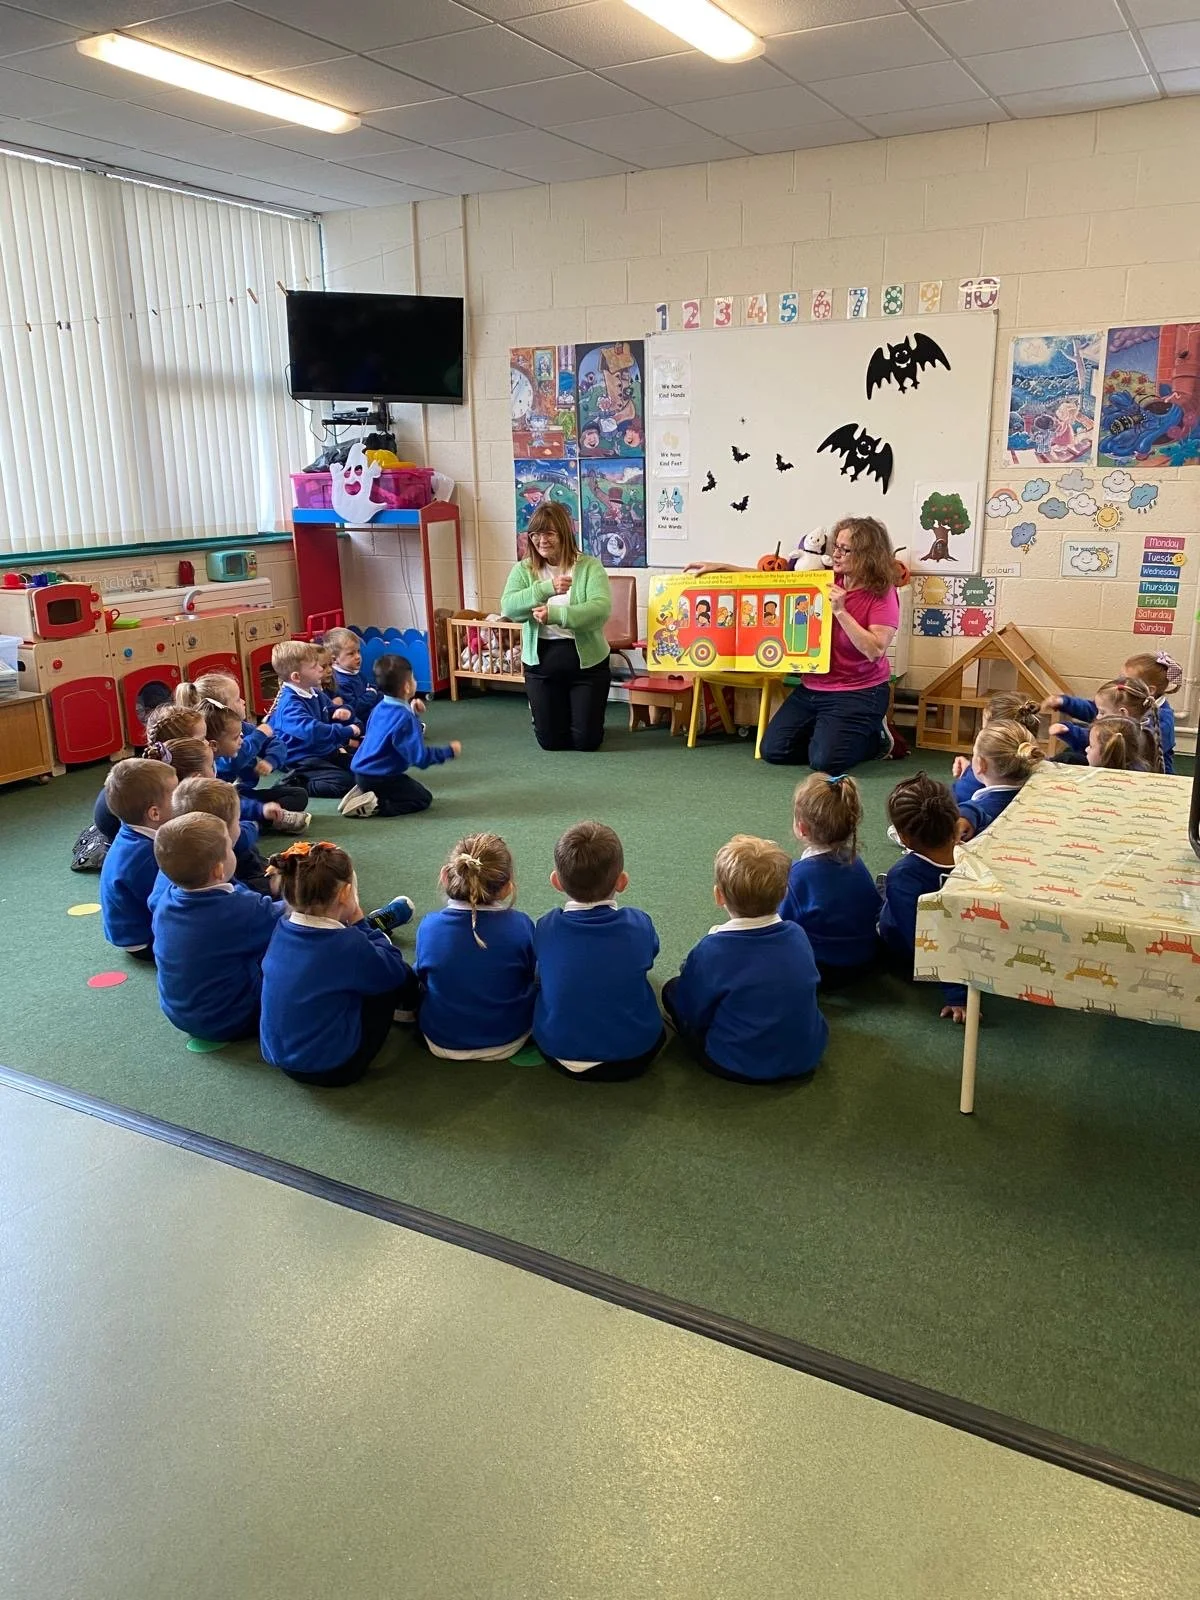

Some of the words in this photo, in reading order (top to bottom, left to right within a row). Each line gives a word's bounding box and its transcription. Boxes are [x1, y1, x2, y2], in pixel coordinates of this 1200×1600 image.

[656, 304, 667, 331] 1
[684, 302, 699, 329] 2
[715, 301, 731, 326] 3
[747, 296, 766, 323] 4
[780, 294, 797, 322] 5
[813, 290, 831, 319] 6
[850, 289, 866, 316] 7
[883, 285, 903, 315] 8
[921, 282, 939, 312] 9
[960, 278, 998, 309] 10
[1150, 538, 1179, 550] Monday
[987, 566, 1015, 574] colours
[1142, 567, 1178, 578] Wednesday
[1142, 582, 1176, 593] Thursday
[1145, 597, 1169, 607] Friday
[1138, 609, 1172, 620] Saturday
[1140, 623, 1166, 633] Sunday
